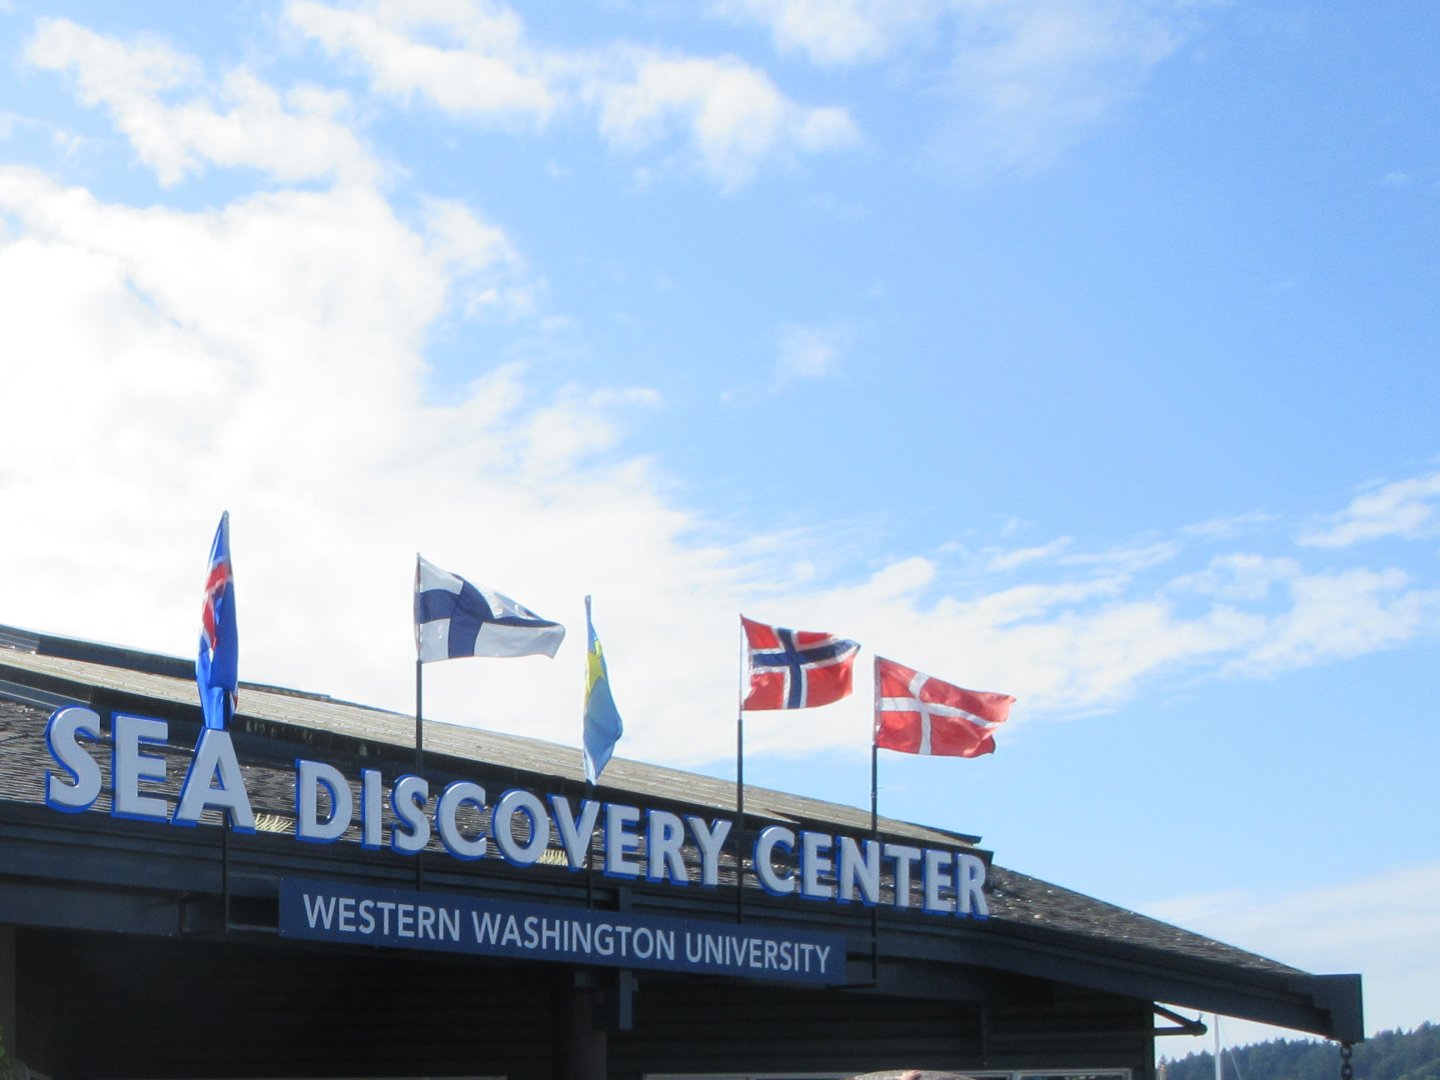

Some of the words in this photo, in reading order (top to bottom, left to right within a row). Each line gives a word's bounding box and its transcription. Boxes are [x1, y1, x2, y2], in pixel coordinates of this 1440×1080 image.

[46, 705, 256, 834] SEA
[295, 759, 733, 886] DISCOVERY
[754, 825, 989, 920] CENTER
[302, 893, 460, 942] WESTERN
[471, 911, 676, 962] WASHINGTON
[684, 932, 832, 974] UNIVERSITY
